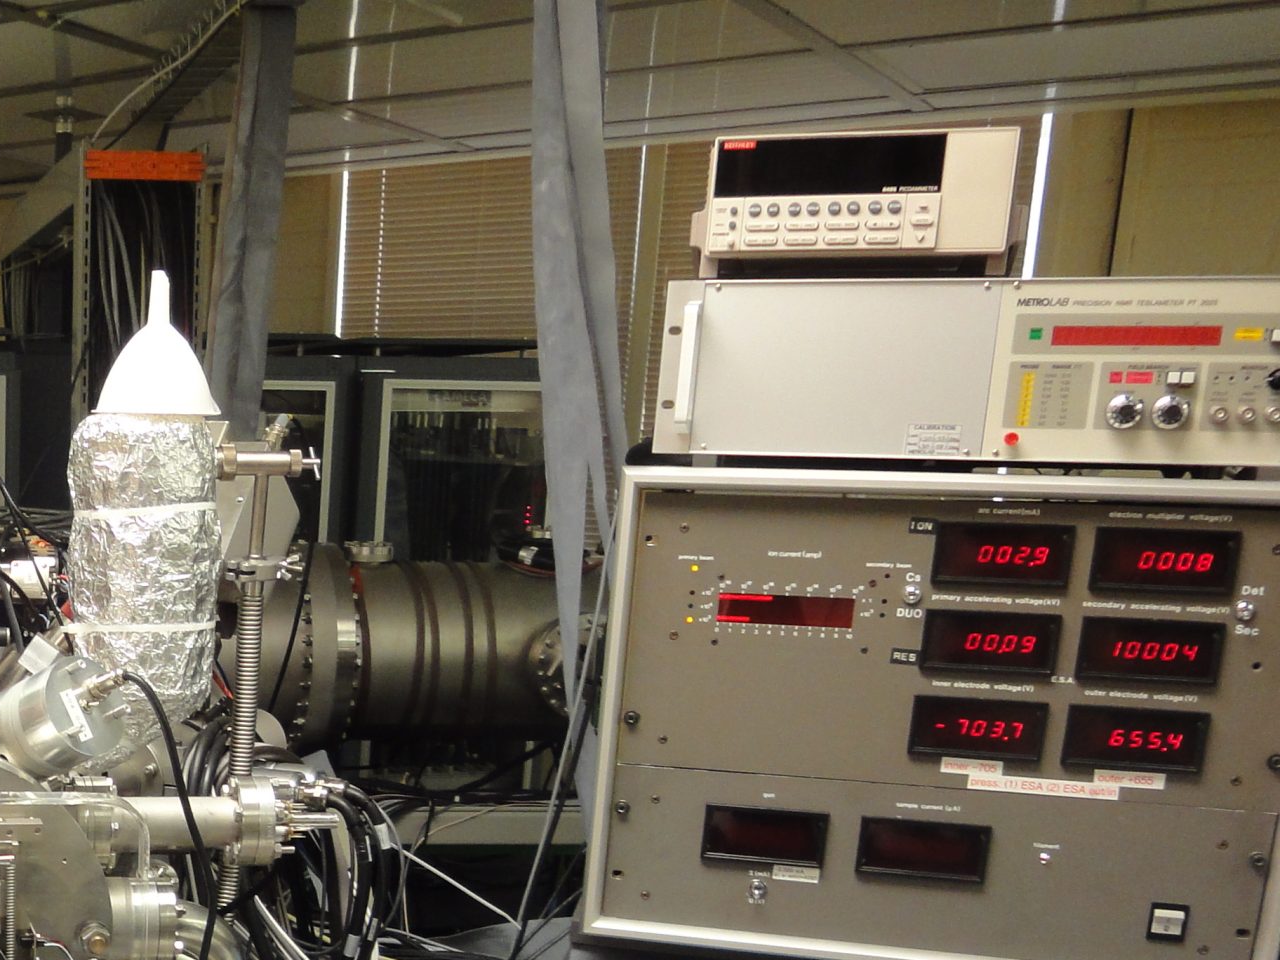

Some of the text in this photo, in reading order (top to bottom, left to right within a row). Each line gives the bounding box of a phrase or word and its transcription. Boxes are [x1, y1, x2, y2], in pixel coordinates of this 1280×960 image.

[1017, 298, 1070, 307] METROLAB
[1072, 299, 1111, 307] PRECISION
[1136, 299, 1185, 307] TESLAMETER
[992, 508, 1041, 516] current(mA)
[1108, 511, 1233, 523] electron multiplier voltage(V)
[678, 554, 698, 562] primary
[768, 549, 778, 557] ion
[778, 550, 801, 558] current
[1137, 551, 1214, 572] 0008
[905, 572, 921, 582] Cs
[931, 593, 1061, 607] primary accelerating voltage(kV)
[896, 608, 922, 618] DUO
[1082, 600, 1231, 615] secondary accelerating voltage(V)
[1234, 624, 1260, 636] Sec
[893, 651, 917, 662] RES
[1112, 641, 1198, 661] 10004
[953, 681, 991, 690] electrode
[993, 683, 1035, 693] voltage(V)
[1084, 689, 1199, 703] outer electrode voltage(V)
[1107, 729, 1184, 752] 655.4
[944, 759, 970, 771] inner
[1097, 774, 1125, 784] outer
[1004, 779, 1018, 790] (1)
[1022, 780, 1043, 791] ESA
[1046, 782, 1060, 793] (2)
[1063, 783, 1086, 795] ESA
[920, 803, 943, 811] current
